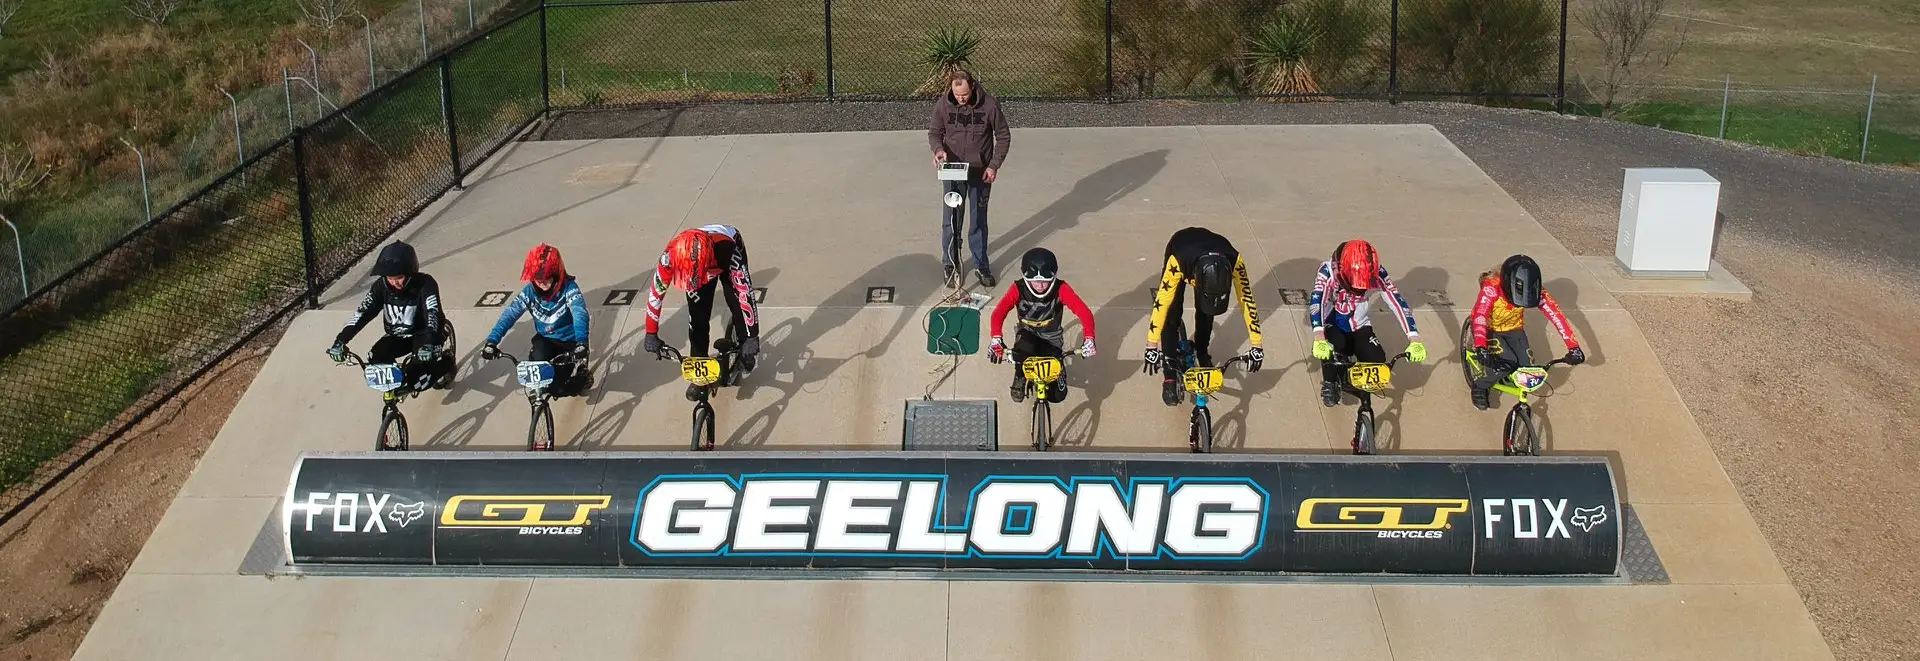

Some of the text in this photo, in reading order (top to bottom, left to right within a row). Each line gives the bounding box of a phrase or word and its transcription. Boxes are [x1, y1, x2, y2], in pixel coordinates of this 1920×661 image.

[1235, 262, 1261, 335] FASTHOUSE
[375, 367, 395, 385] 174
[527, 365, 541, 382] 13
[694, 361, 708, 377] 85
[1035, 360, 1051, 378] 117
[1364, 367, 1380, 383] 23
[1197, 371, 1211, 388] 87
[305, 492, 391, 533] FOX
[440, 495, 612, 526] GT
[638, 480, 1262, 554] GEELONG
[1296, 498, 1469, 529] GT
[1483, 499, 1572, 538] FOX
[518, 526, 584, 536] BICYCLES
[1377, 530, 1443, 539] BICYCLES
